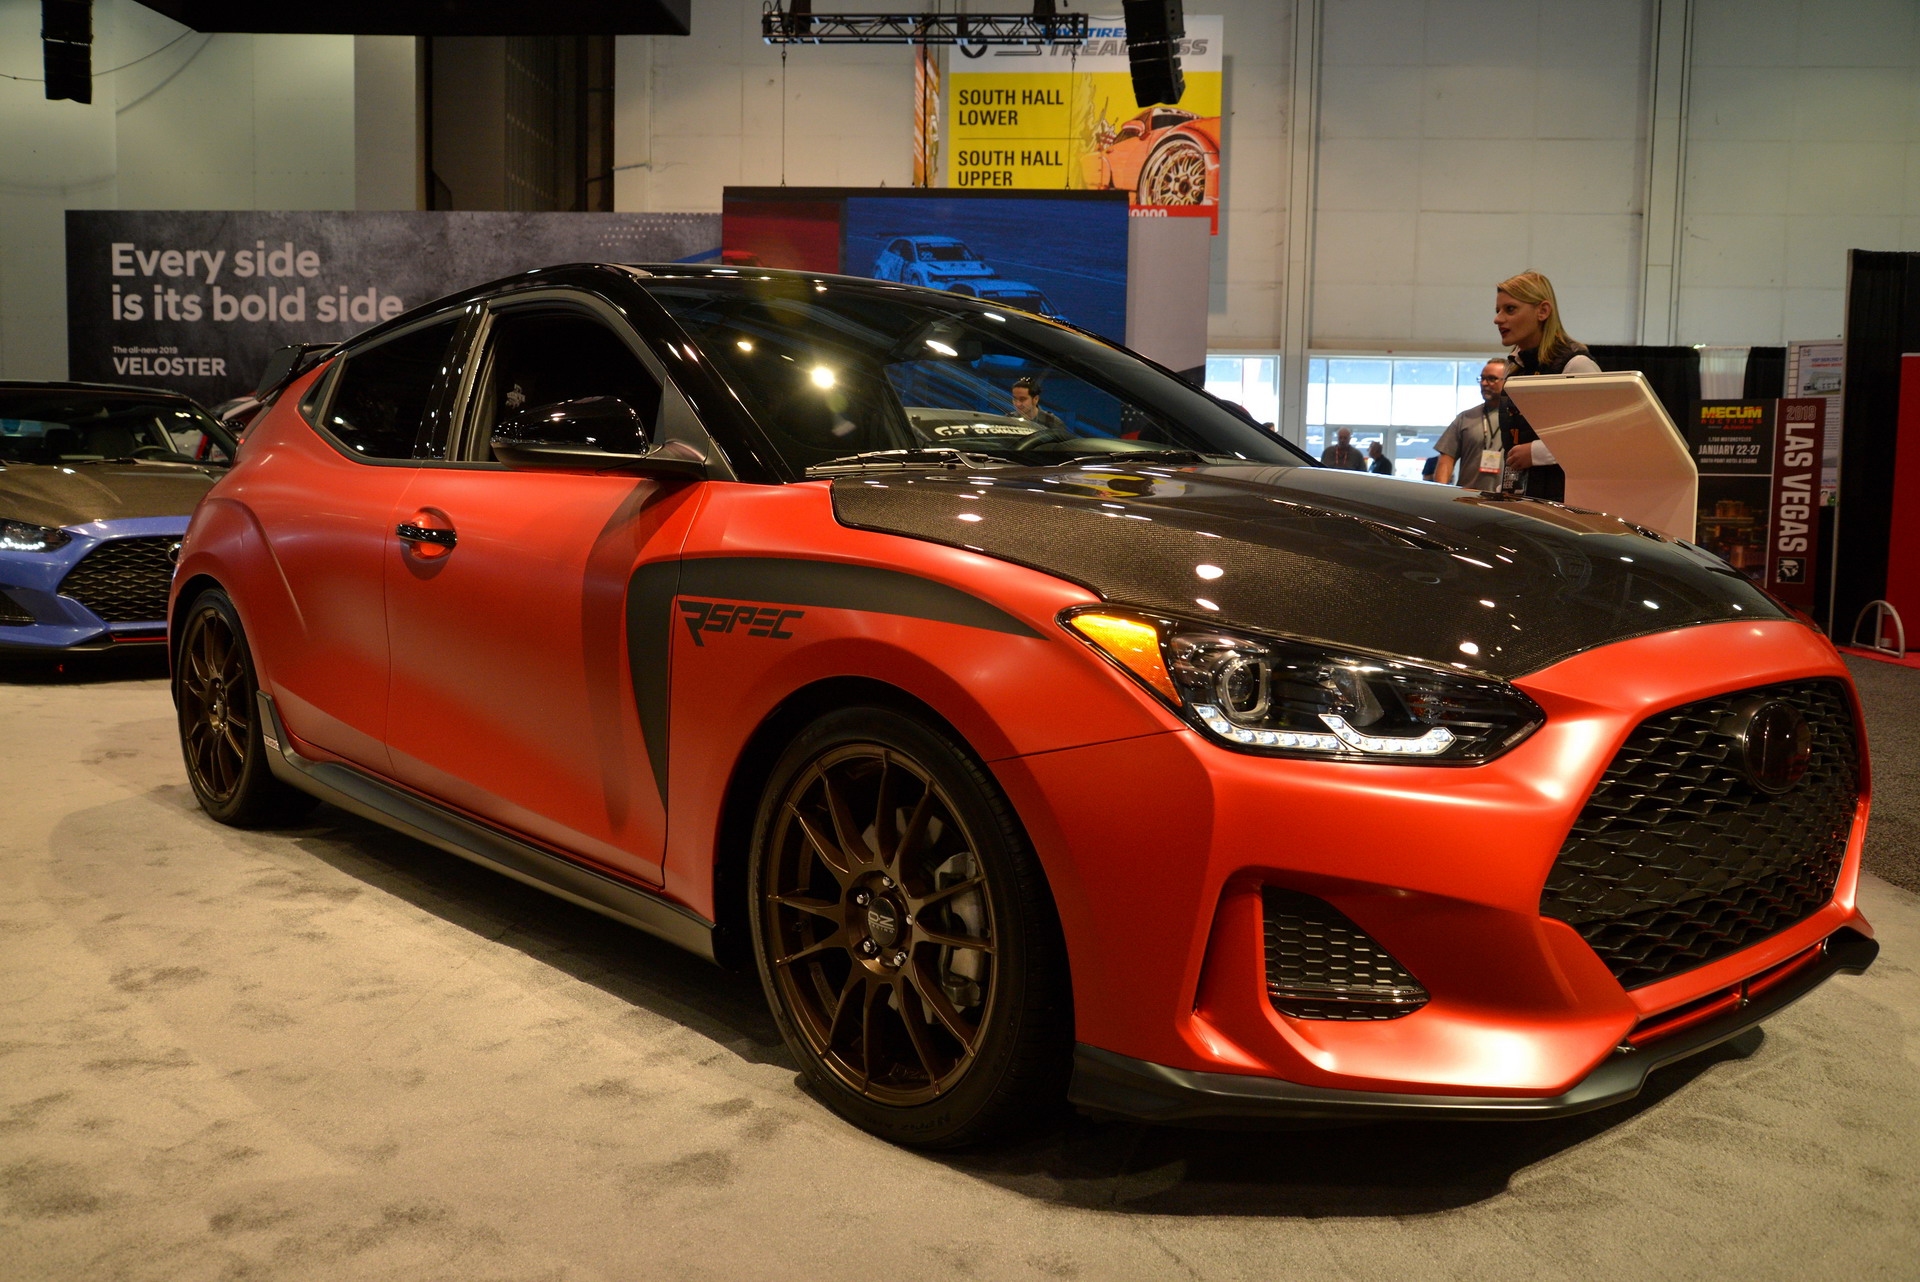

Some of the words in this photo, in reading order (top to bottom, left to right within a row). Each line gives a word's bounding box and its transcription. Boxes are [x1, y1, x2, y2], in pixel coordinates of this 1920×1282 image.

[1088, 27, 1126, 37] TIRE
[958, 89, 1016, 106] SOUTH
[1022, 89, 1064, 106] HALL
[958, 110, 1019, 126] LOWER
[957, 150, 1015, 167] SOUTH
[1021, 150, 1063, 167] HALL
[957, 170, 1013, 187] UPPER
[111, 243, 225, 284] Every
[233, 240, 320, 277] side
[112, 284, 143, 321] is
[154, 284, 203, 321] its
[213, 286, 305, 322] bold
[316, 285, 404, 322] side
[113, 346, 128, 354] The
[128, 346, 158, 354] all-new
[112, 357, 227, 376] VELOSTER
[1701, 406, 1763, 418] MECUM
[1786, 405, 1816, 421] 2019
[1698, 444, 1735, 455] JANUARY
[1736, 444, 1761, 455] 22-27
[1783, 422, 1815, 467] LAS
[1778, 473, 1812, 552] VEGAS
